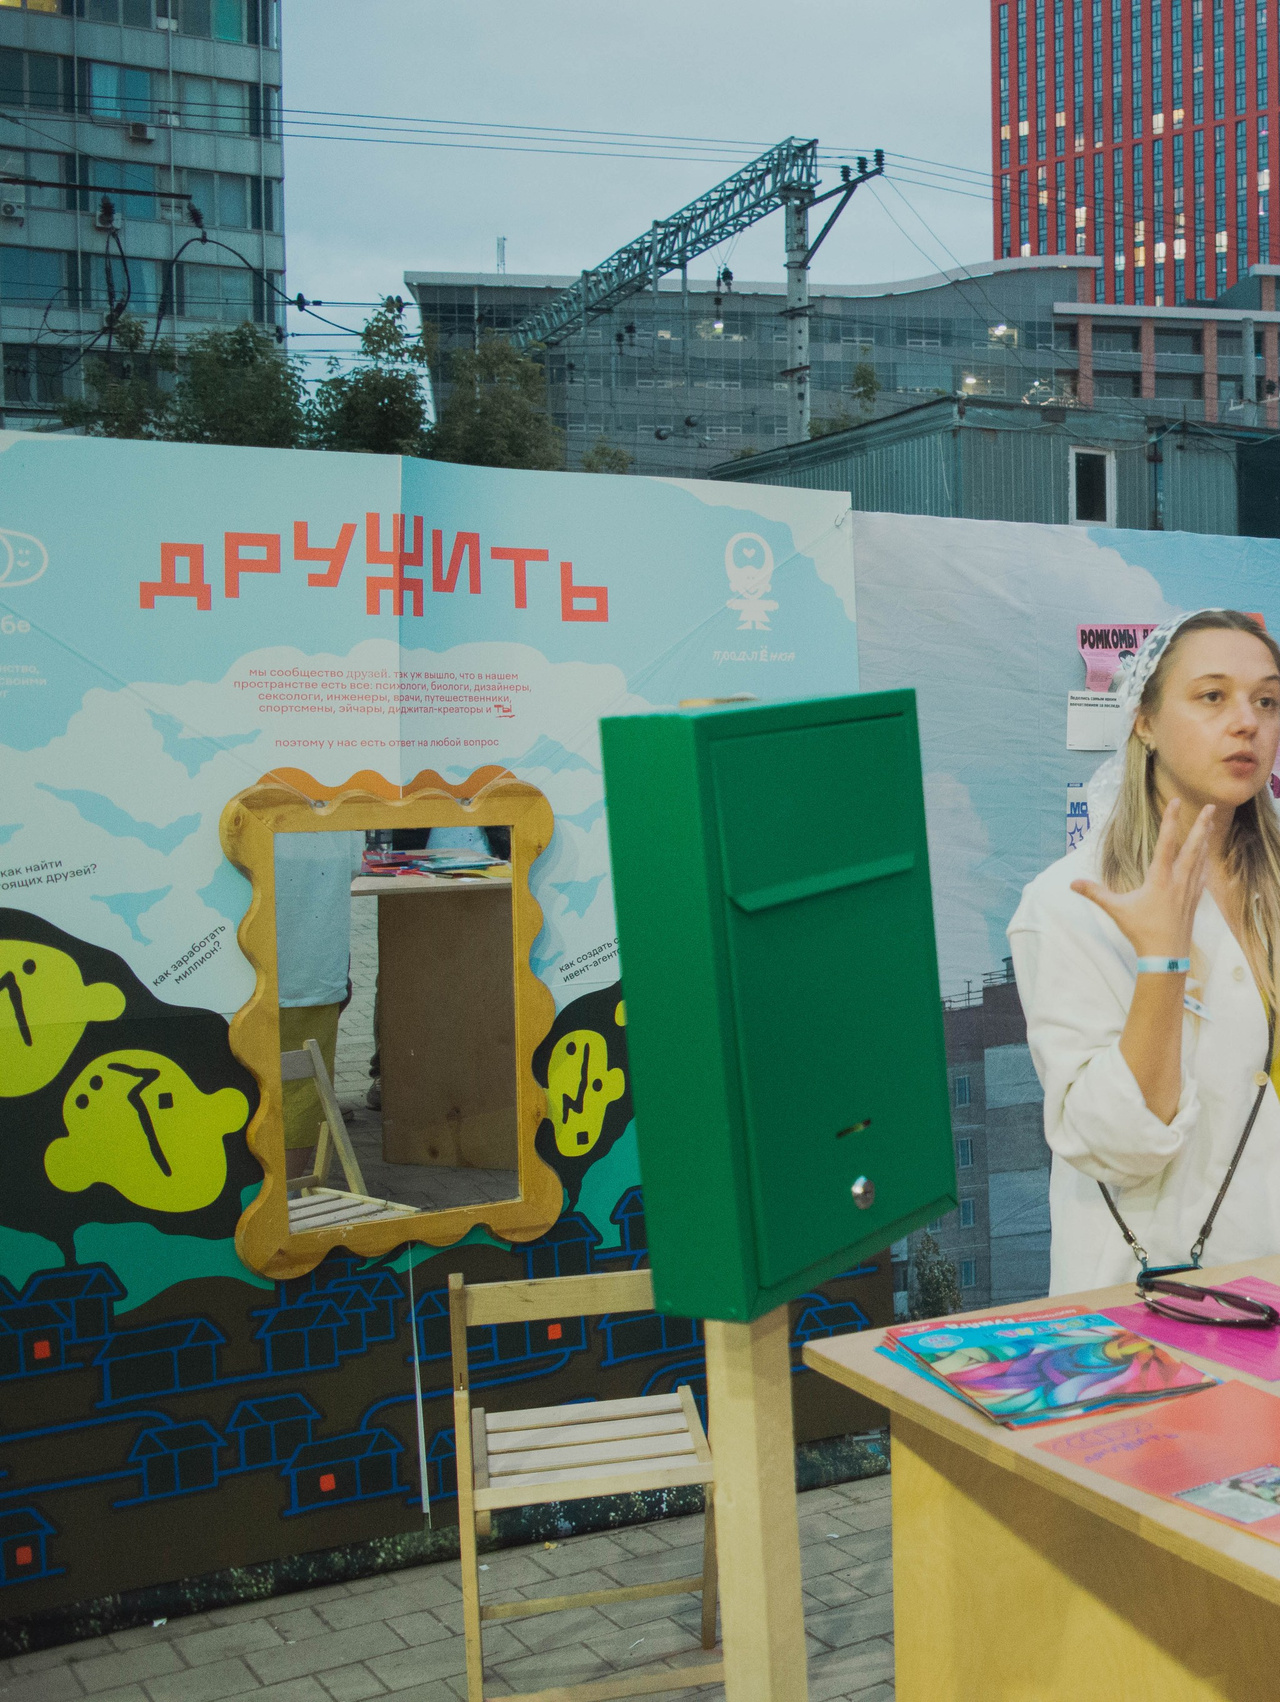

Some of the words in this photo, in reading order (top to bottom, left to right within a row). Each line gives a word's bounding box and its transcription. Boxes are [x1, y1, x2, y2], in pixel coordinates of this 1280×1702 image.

[139, 512, 609, 623] ДРУЖИТЬ
[1080, 628, 1138, 650] РОМКОМЫ
[249, 668, 267, 677] мы
[269, 667, 344, 678] сообщество
[345, 668, 391, 681] друзей.
[393, 671, 409, 679] так
[410, 672, 422, 681] уж
[424, 672, 458, 681] вышло,
[459, 672, 475, 680] что
[233, 680, 318, 691] пространстве
[320, 681, 347, 690] есть
[349, 682, 373, 690] все:
[375, 682, 429, 692] психологи,
[430, 680, 472, 692] биологи,
[473, 682, 532, 694] дизайнеры,
[257, 692, 323, 702] сексологи,
[326, 693, 390, 703] инженеры,
[393, 694, 422, 704] врачи,
[424, 694, 512, 704] путешественники,
[258, 704, 336, 714] спортсмены,
[338, 703, 385, 715] эйчары,
[388, 704, 484, 716] диджитал-креаторы
[485, 706, 492, 714] и
[275, 739, 325, 749] поэтому
[327, 739, 334, 749] у
[336, 739, 358, 747] нас
[360, 739, 386, 747] есть
[388, 739, 415, 748] ответ
[417, 739, 428, 747] на
[429, 736, 462, 747] любой
[463, 738, 499, 749] вопрос
[0, 876, 43, 891] оящих
[46, 863, 97, 885] друзей?
[1, 867, 22, 878] как
[25, 859, 63, 873] найти
[152, 969, 173, 988] как
[170, 924, 227, 973] заработать
[174, 940, 223, 985] миллион?
[558, 960, 577, 973] как
[576, 941, 613, 964] создать
